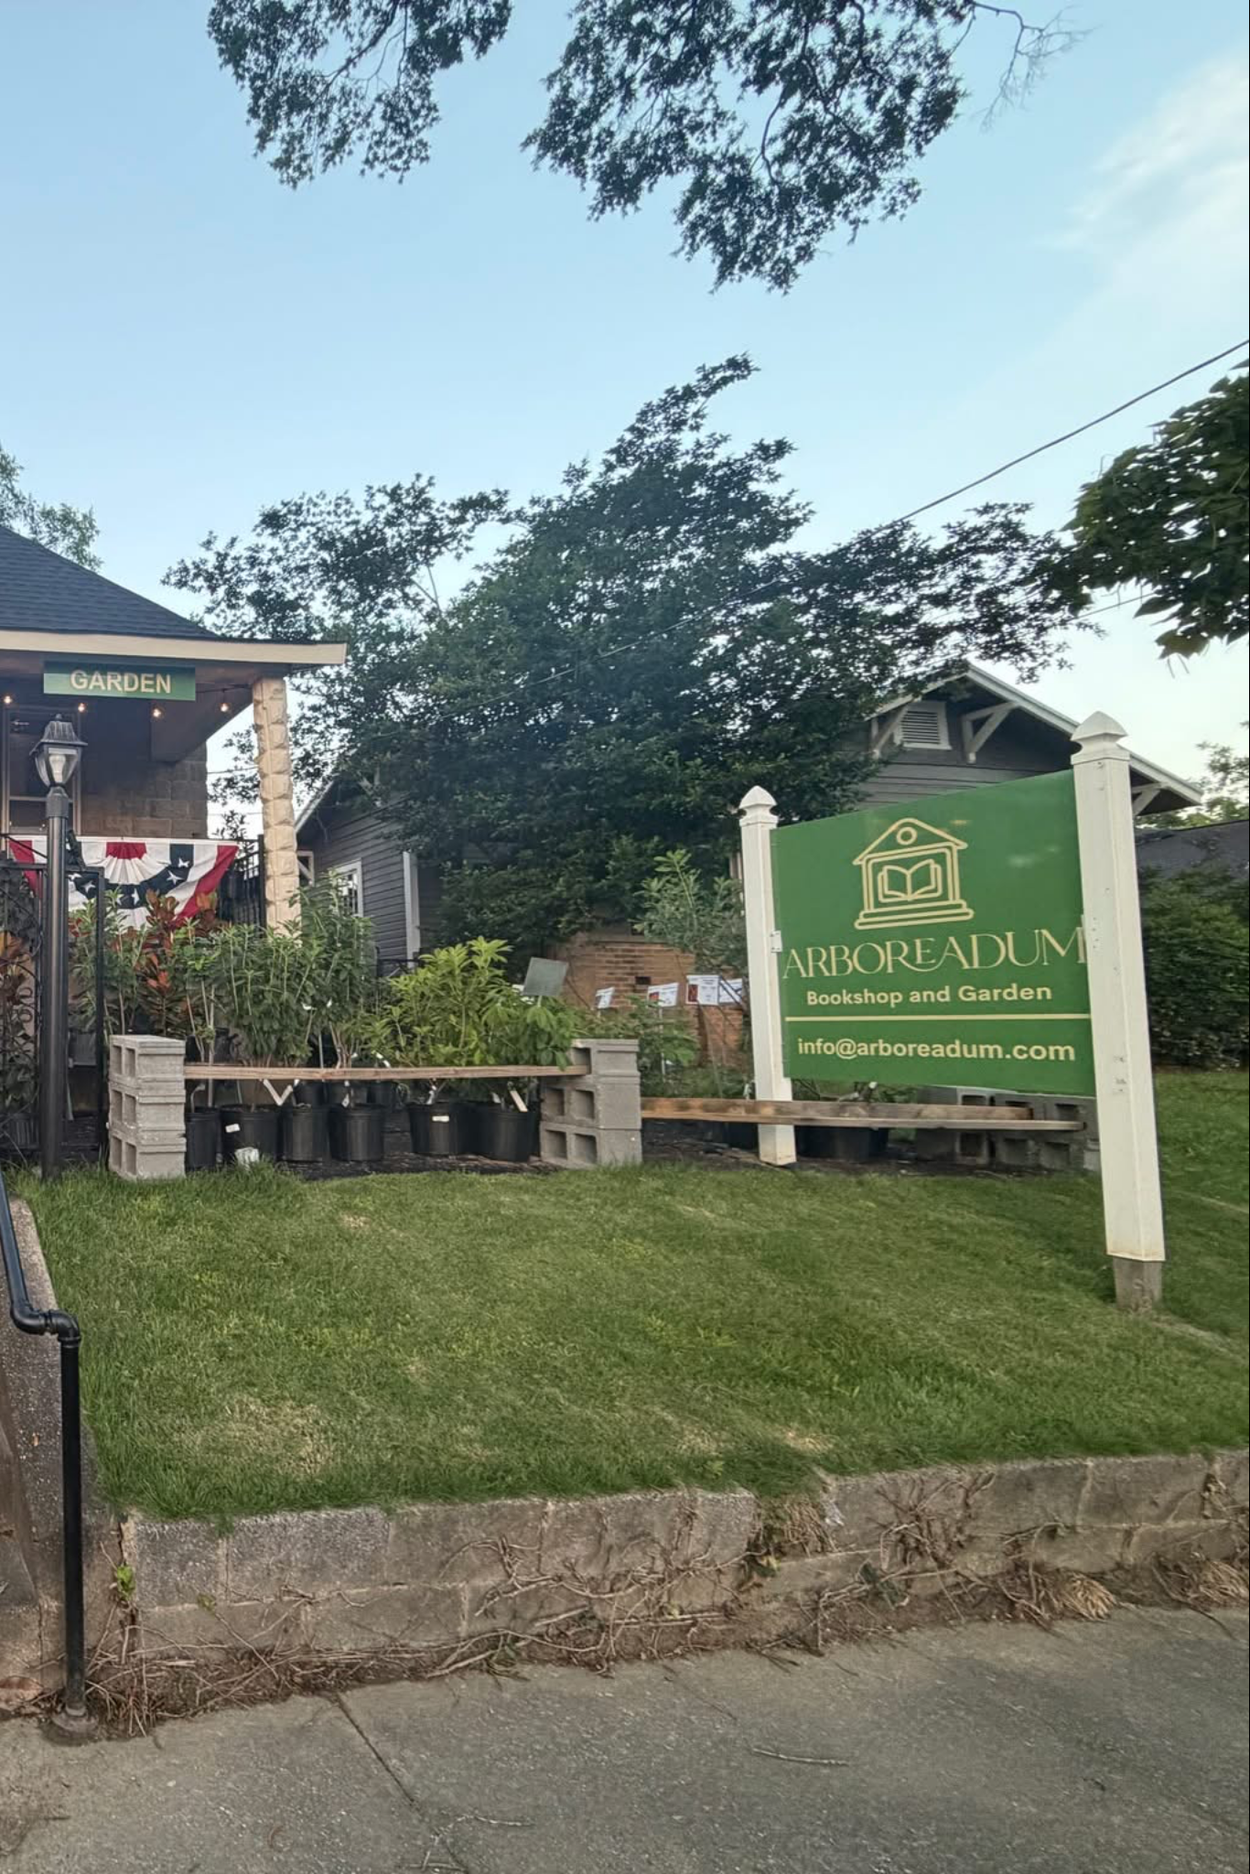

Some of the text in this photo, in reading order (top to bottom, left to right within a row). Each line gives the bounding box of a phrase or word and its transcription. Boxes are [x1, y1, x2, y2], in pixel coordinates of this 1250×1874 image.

[70, 669, 172, 694] GARDEN
[783, 927, 1086, 978] ARBOREADUM
[806, 983, 1053, 1007] Bookshop and Garden
[798, 1038, 1076, 1061] info@arboreadum.com
